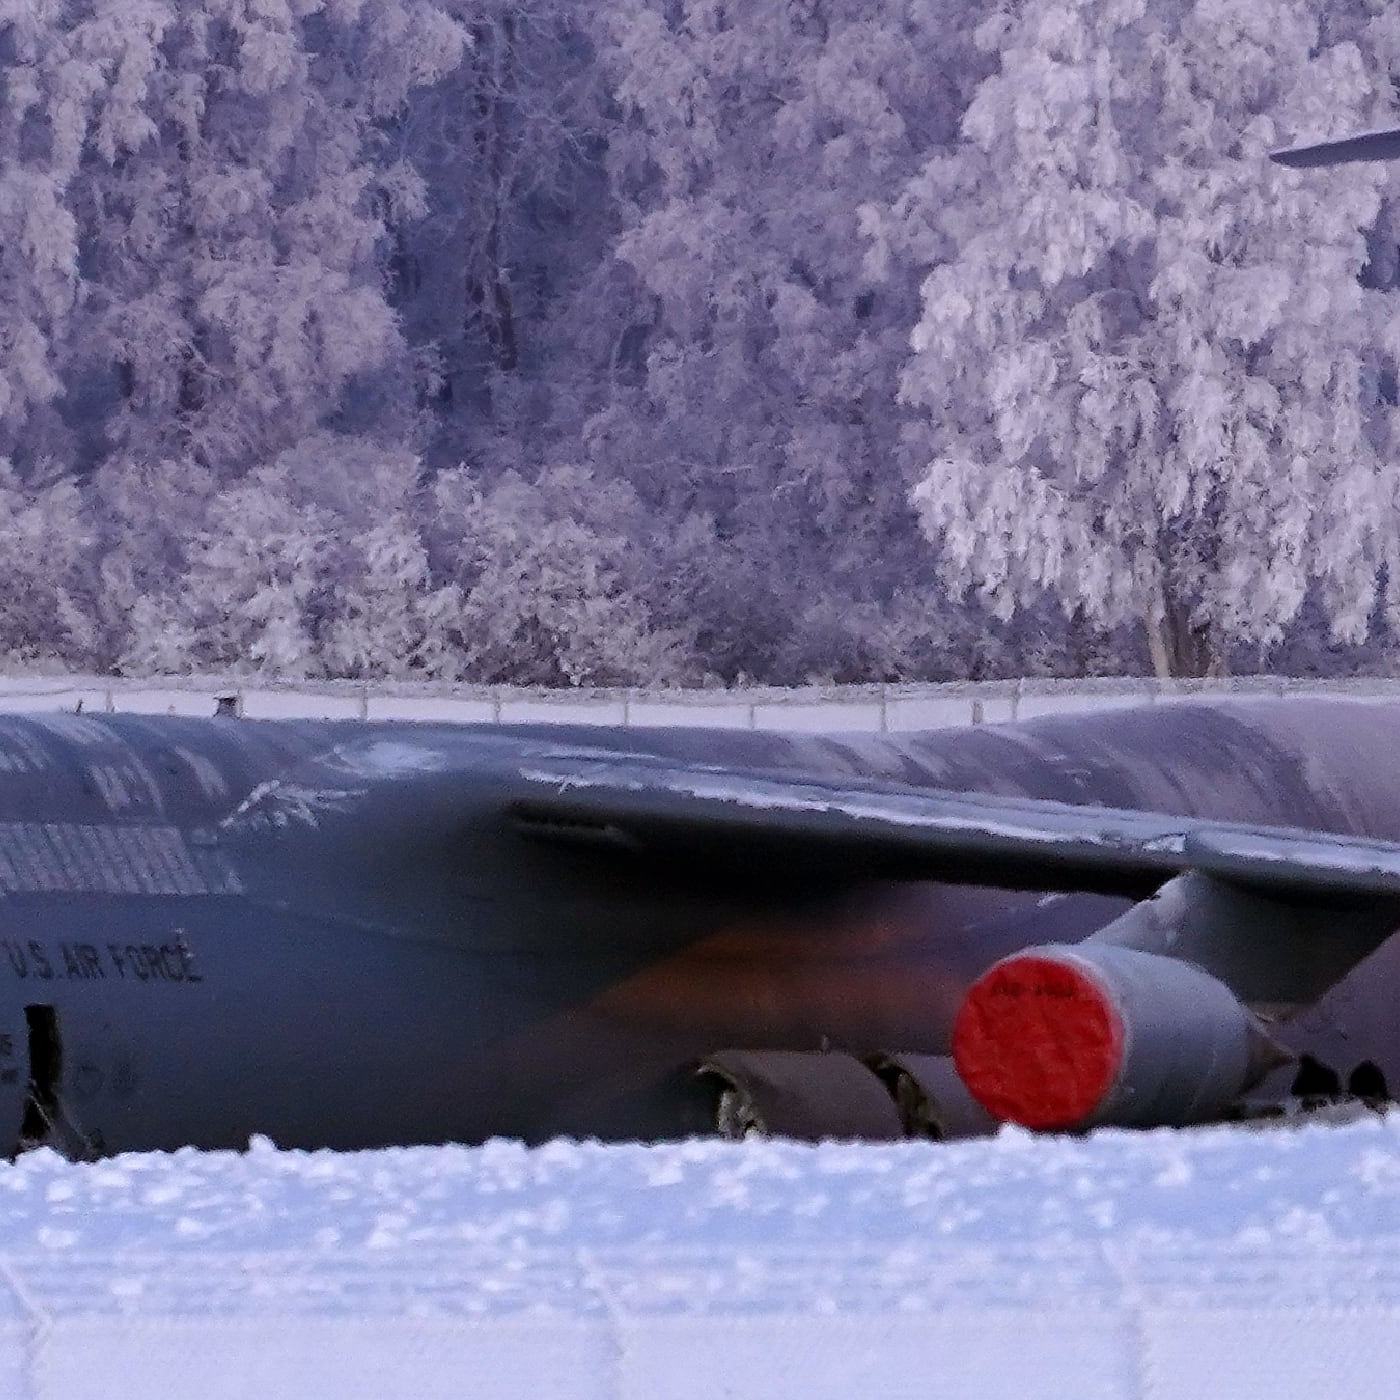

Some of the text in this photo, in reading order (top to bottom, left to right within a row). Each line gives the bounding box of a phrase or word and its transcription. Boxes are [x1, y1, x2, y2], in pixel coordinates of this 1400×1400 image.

[1, 938, 203, 983] U.S. AIR FORCE
